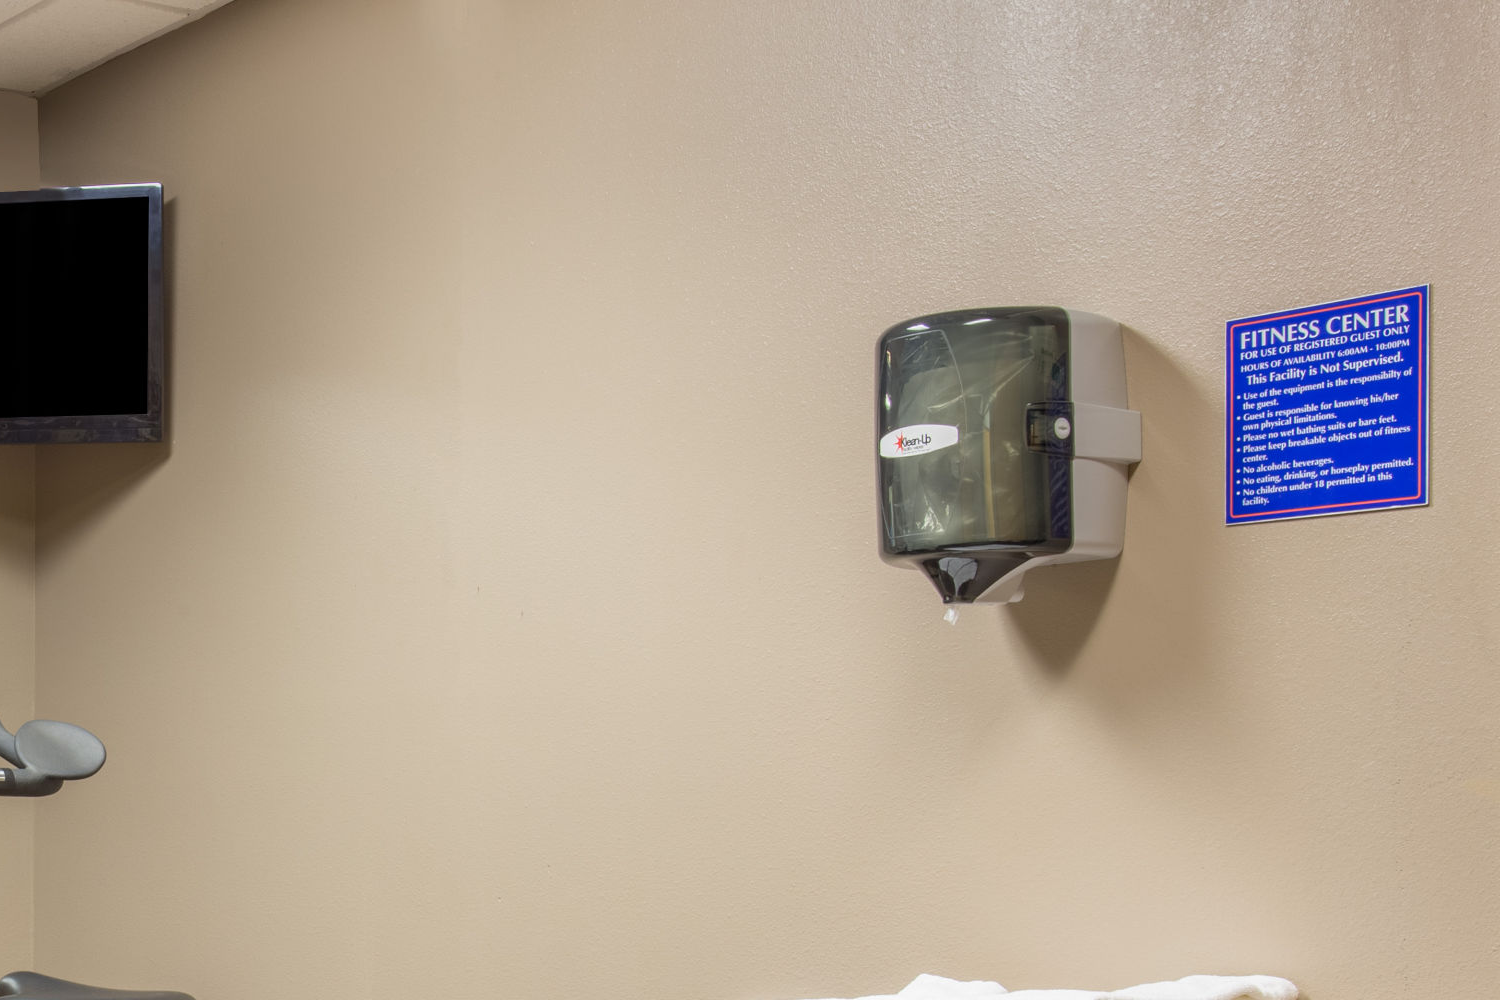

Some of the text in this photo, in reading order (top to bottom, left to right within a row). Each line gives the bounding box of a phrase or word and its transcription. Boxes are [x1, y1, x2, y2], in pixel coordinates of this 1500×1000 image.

[1240, 304, 1409, 349] FITNESS CENTER
[1240, 325, 1410, 360] FOR USE OF REGISTERED GUEST ONLY
[1241, 362, 1269, 372] HOURS
[1271, 360, 1282, 368] OF
[1283, 351, 1335, 366] AVAILABILITY
[1338, 347, 1368, 357] 6:00AM
[1376, 339, 1410, 351] 10:00PM
[1246, 352, 1403, 386] This Facility is Not Supervised.
[1243, 367, 1412, 400] Use of the equipment is the responsibilty of
[1242, 399, 1279, 411] the guest.
[1243, 393, 1399, 421] Guest is responsible for knowing his/her
[1242, 412, 1337, 431] own physical limitations.
[1243, 434, 1266, 442] Please
[1280, 429, 1294, 437] wet
[1296, 424, 1326, 435] bathing
[1328, 421, 1346, 430] suits
[1359, 418, 1377, 426] bare
[1379, 415, 1397, 424] feet.
[1243, 445, 1266, 453] Please
[1268, 442, 1286, 450] keep
[1288, 436, 1326, 447] breakable
[1328, 433, 1356, 443] objects
[1374, 428, 1383, 436] of
[1385, 425, 1411, 435] fitness
[1242, 454, 1268, 463] center.
[1257, 462, 1291, 473] alcoholic
[1293, 458, 1334, 468] beverages.
[1257, 474, 1281, 484] eating,
[1284, 469, 1318, 481] drinking,
[1331, 464, 1369, 476] horseplay
[1372, 458, 1414, 471] permitted.
[1242, 488, 1254, 496] No
[1257, 483, 1288, 494] children
[1289, 481, 1312, 490] under
[1315, 480, 1324, 488] 18
[1326, 475, 1365, 488] permitted
[1378, 472, 1392, 480] this
[1242, 497, 1270, 506] facility.
